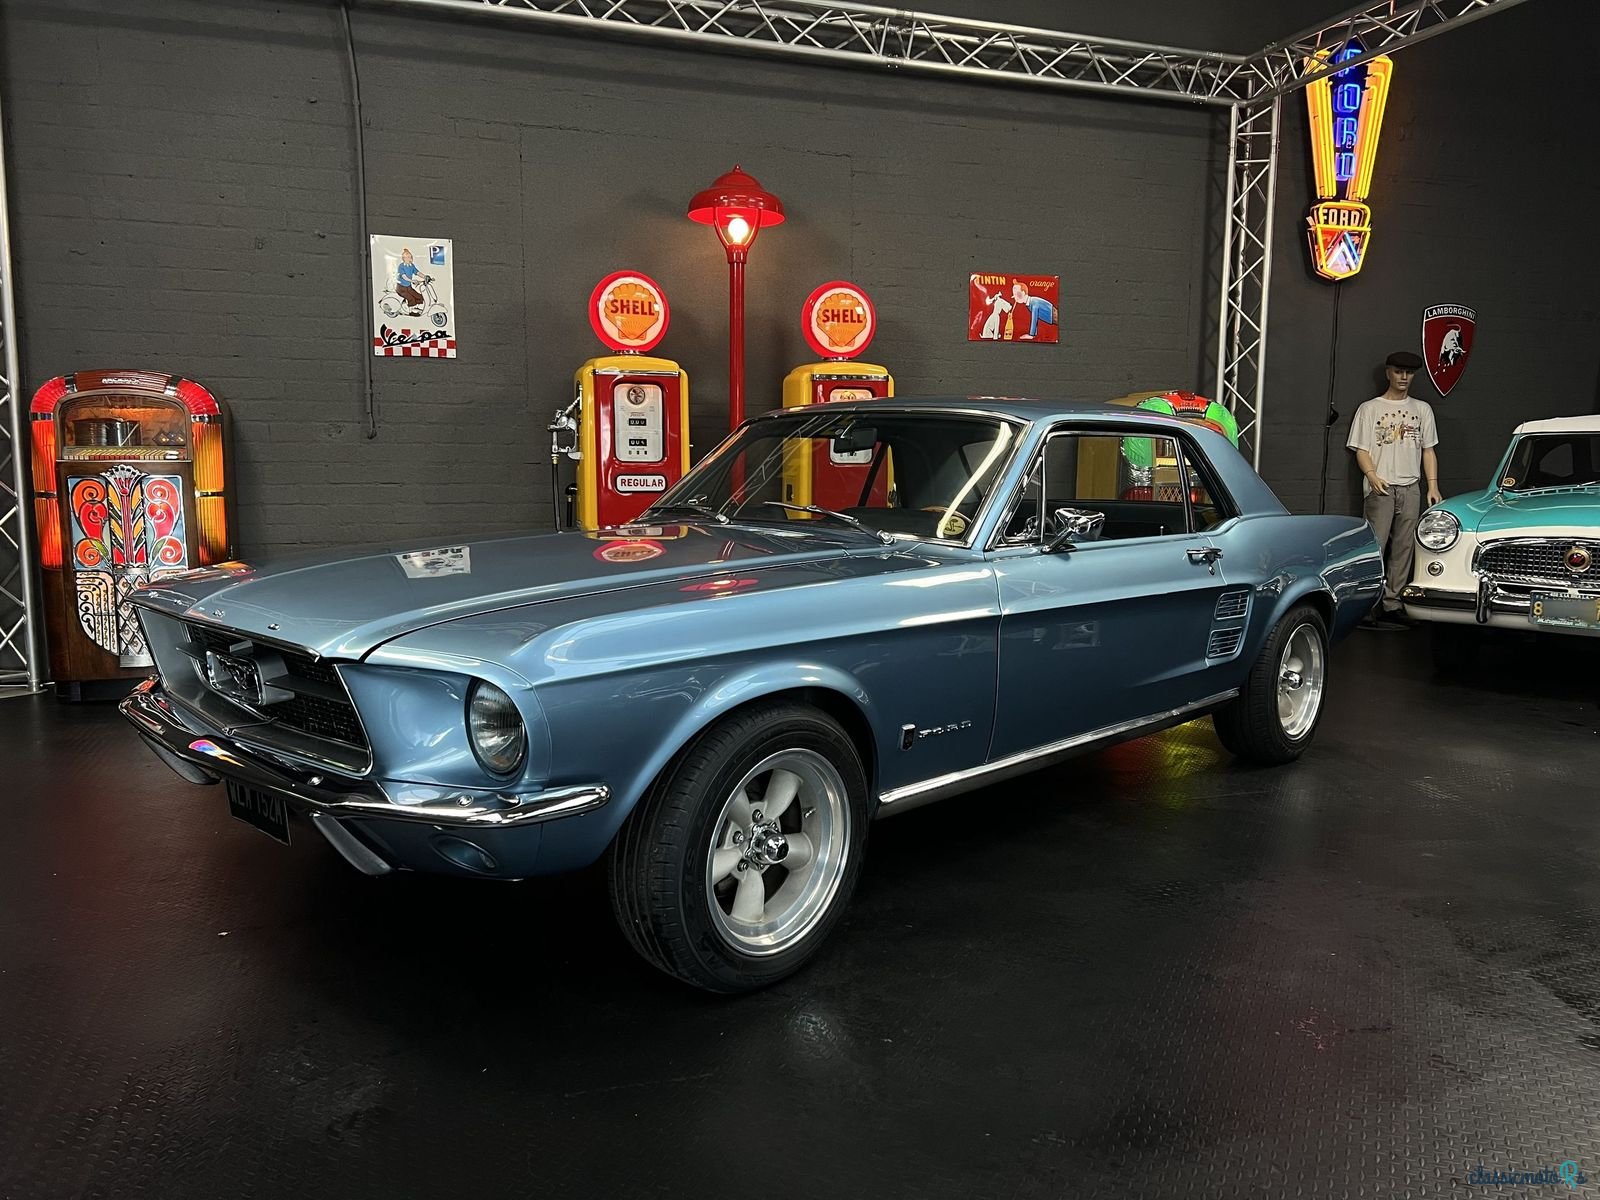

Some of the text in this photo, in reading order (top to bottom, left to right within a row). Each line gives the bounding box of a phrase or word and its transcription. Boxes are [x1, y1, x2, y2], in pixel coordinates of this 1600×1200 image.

[1322, 208, 1361, 227] FORD
[975, 275, 1055, 291] TINTIN orange
[610, 299, 655, 316] SHELL
[1427, 307, 1476, 320] LAMBORGHINI
[822, 309, 863, 323] SHELL
[620, 478, 664, 487] REGULAR
[918, 720, 972, 738] FORD
